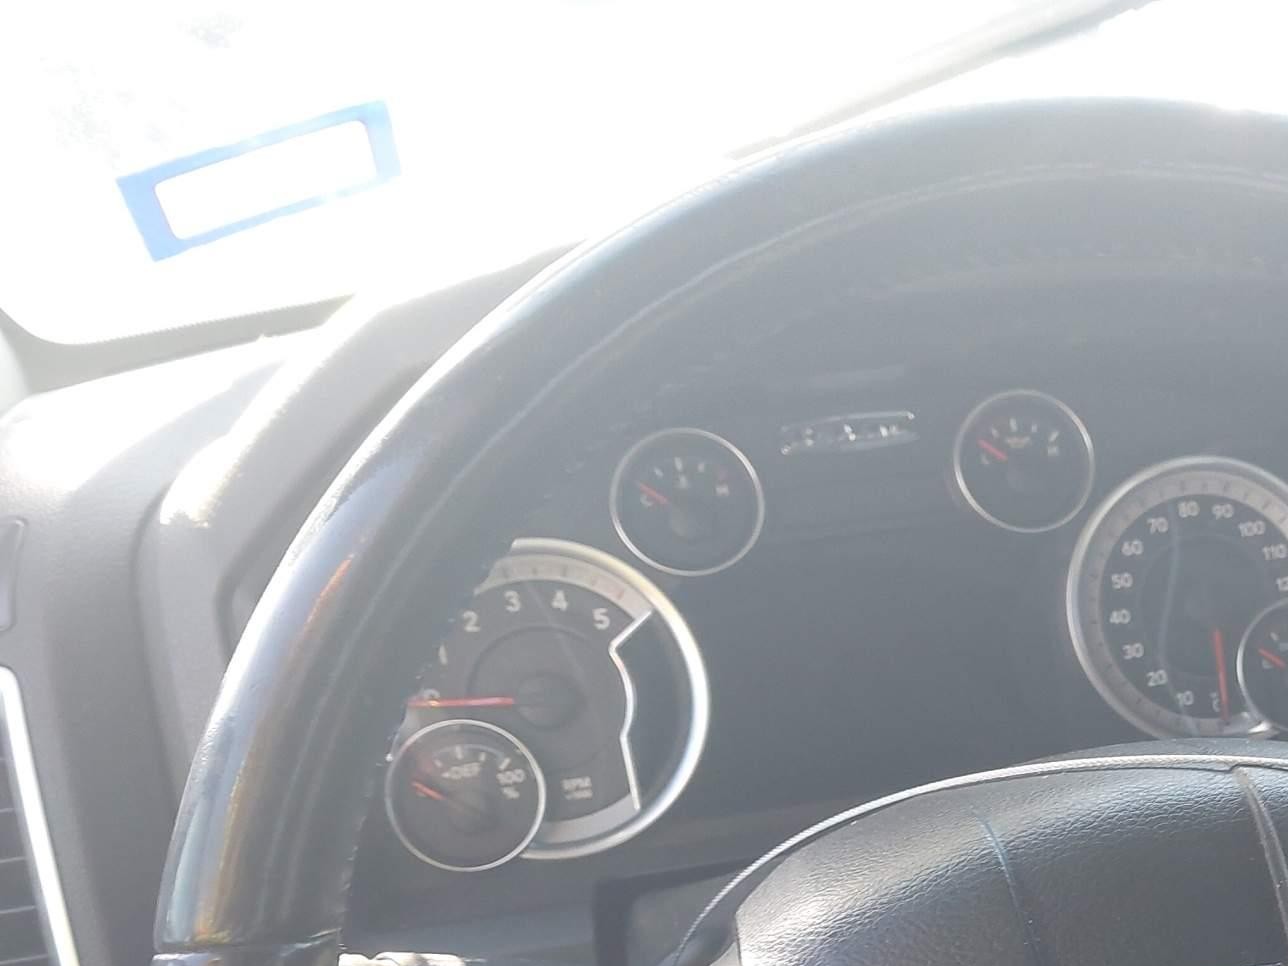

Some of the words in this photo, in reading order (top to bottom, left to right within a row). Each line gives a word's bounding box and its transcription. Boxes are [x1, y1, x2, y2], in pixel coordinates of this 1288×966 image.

[1178, 501, 1199, 519] 80
[1212, 503, 1234, 520] 90
[1147, 517, 1169, 534] 70
[1238, 519, 1266, 538] 100
[1121, 540, 1143, 556] 60
[1262, 544, 1288, 561] 110
[1111, 573, 1133, 590] 50
[504, 590, 521, 612] 3
[551, 589, 569, 611] 4
[462, 609, 480, 632] 2
[592, 607, 611, 630] 5
[1109, 609, 1131, 625] 40
[1122, 643, 1144, 660] 30
[1146, 669, 1168, 687] 20
[1176, 690, 1195, 707] 10
[496, 769, 526, 785] 100
